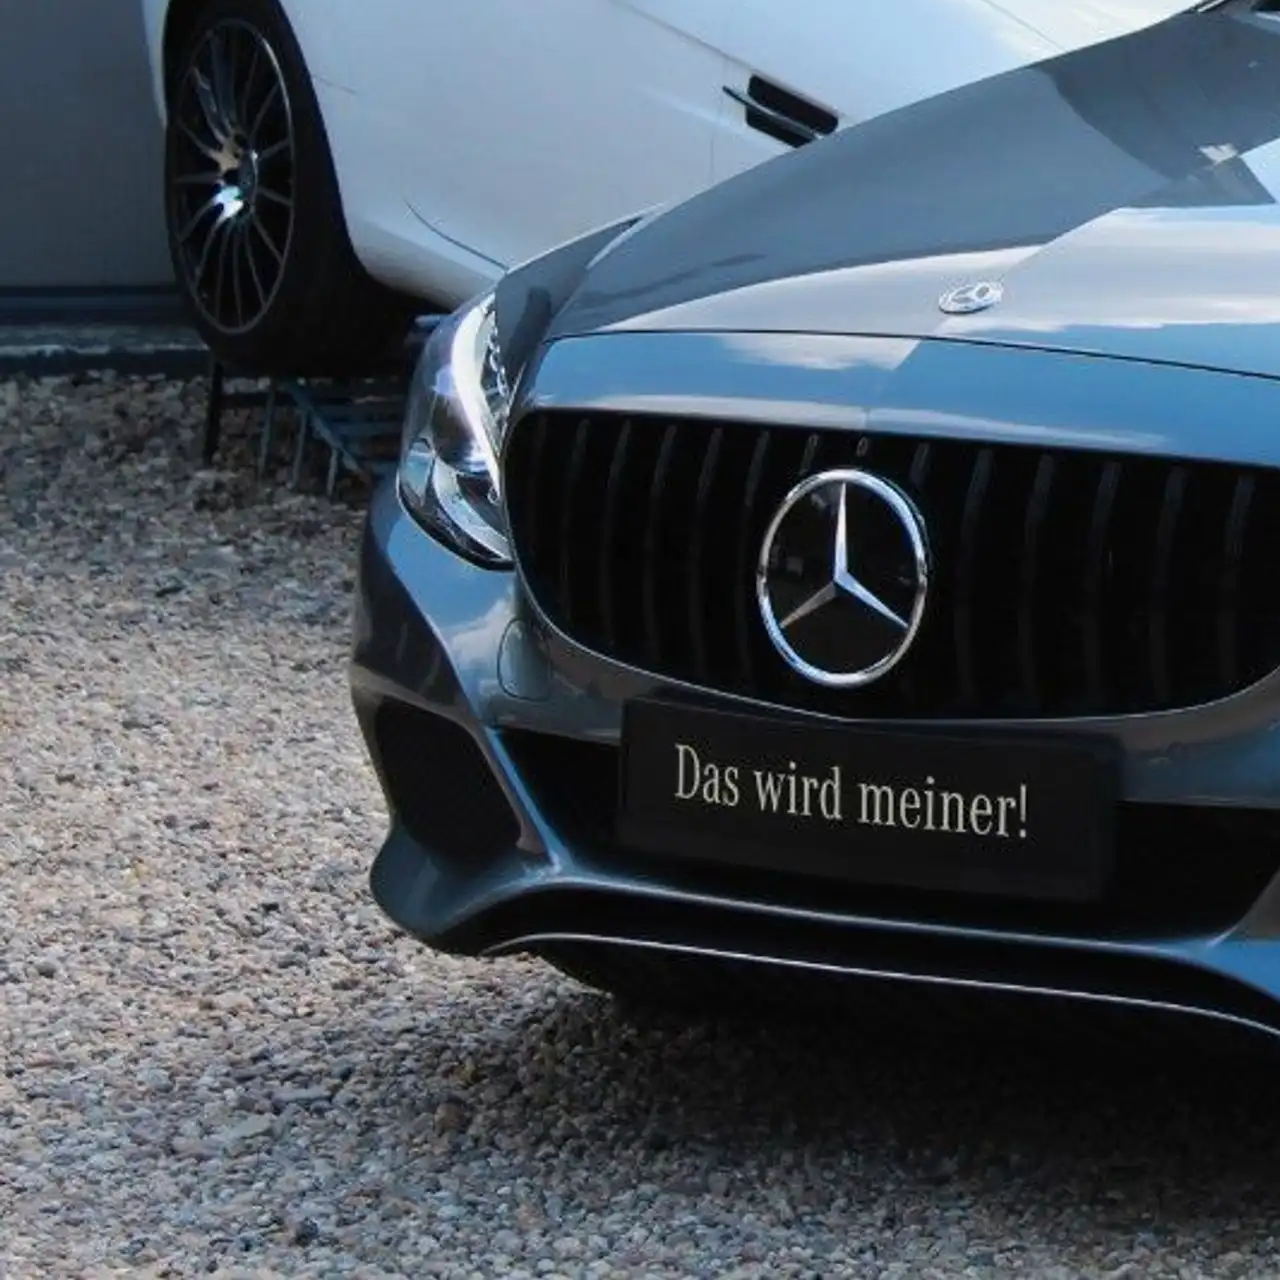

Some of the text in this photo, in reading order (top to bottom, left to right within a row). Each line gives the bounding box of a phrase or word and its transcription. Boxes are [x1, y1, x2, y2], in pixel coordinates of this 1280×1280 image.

[674, 743, 1028, 839] Das wird meiner!
